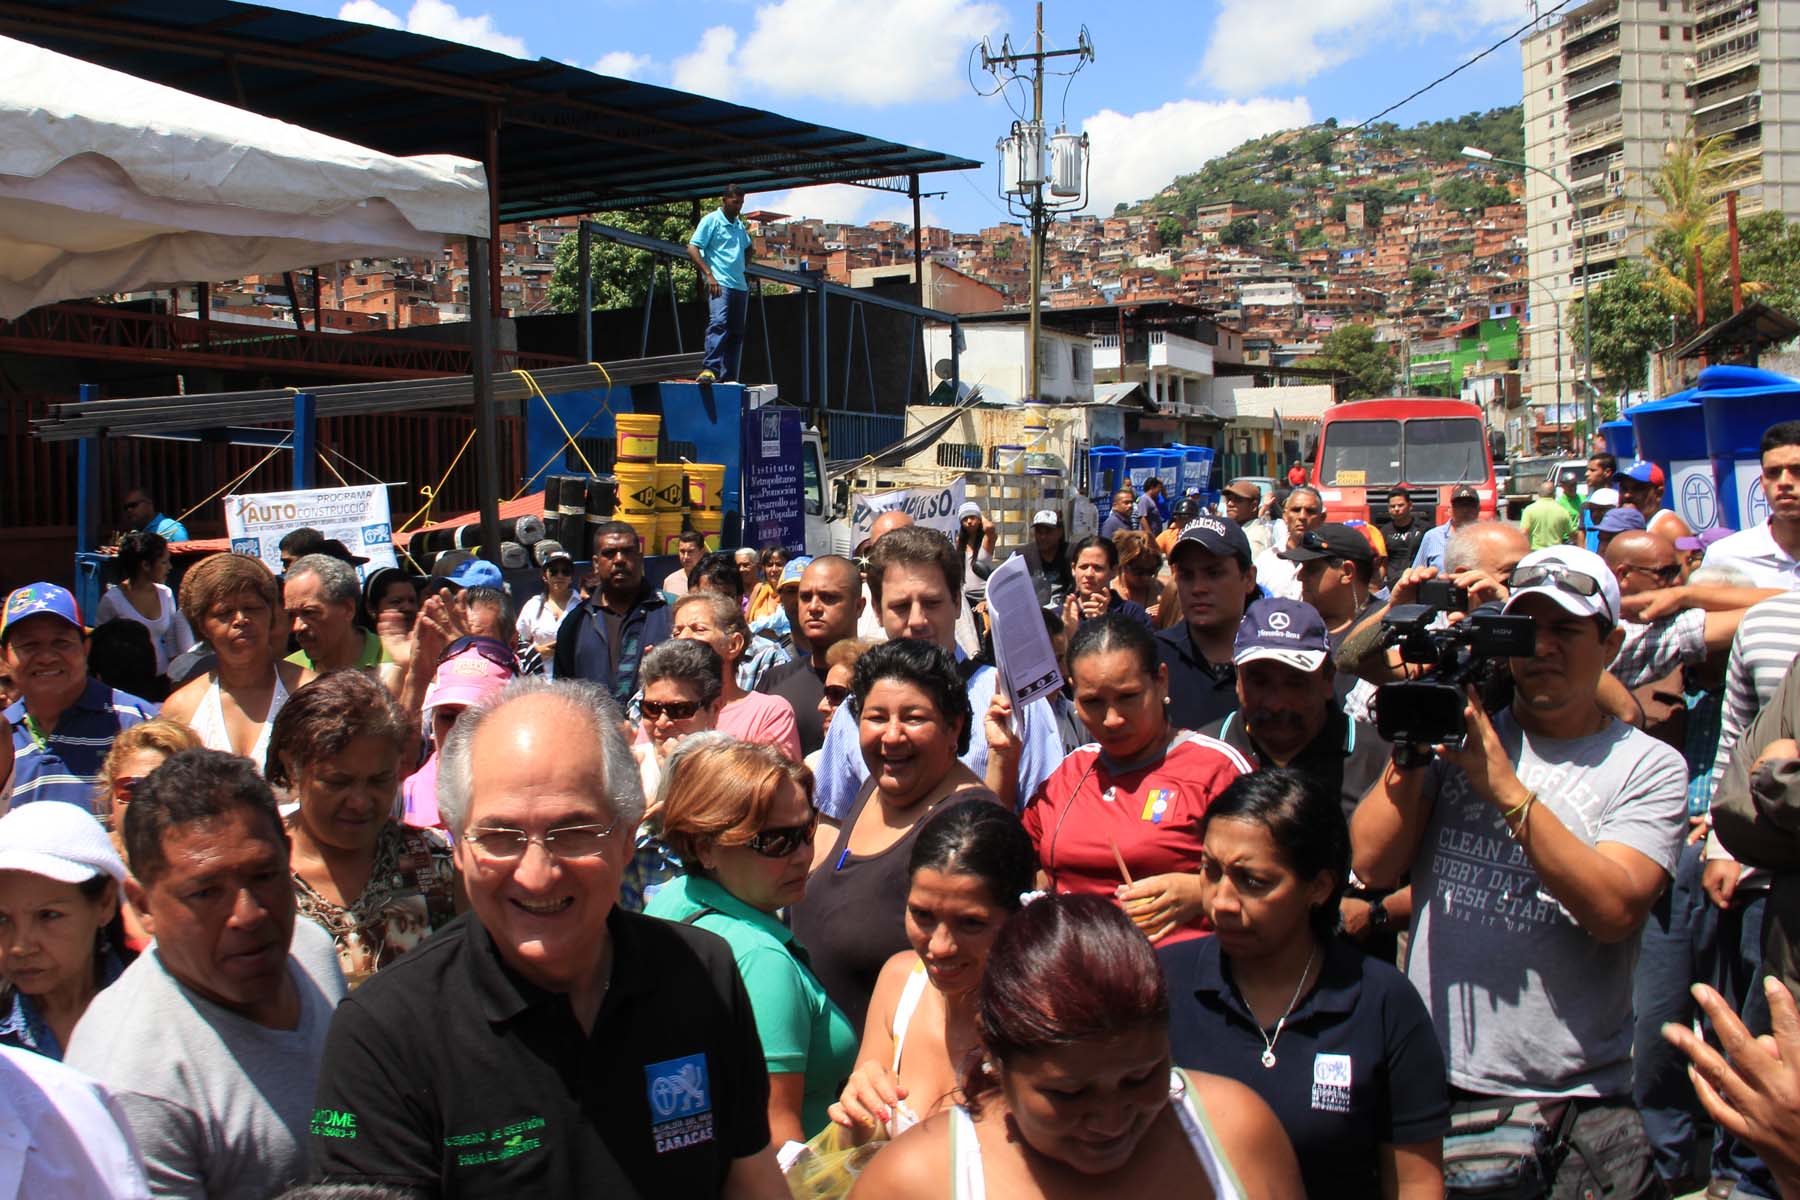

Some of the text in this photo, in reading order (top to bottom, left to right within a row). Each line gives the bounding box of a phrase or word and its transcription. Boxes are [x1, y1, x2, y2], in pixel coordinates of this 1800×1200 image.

[317, 490, 372, 504] PROGRAMA
[770, 508, 799, 522] Popular
[1439, 827, 1503, 862] CLEAN
[1432, 854, 1484, 884] EVERY
[1488, 870, 1531, 893] DAY
[1436, 878, 1560, 925] FRESH START
[1480, 914, 1497, 927] IT
[656, 1127, 713, 1153] CARACAS
